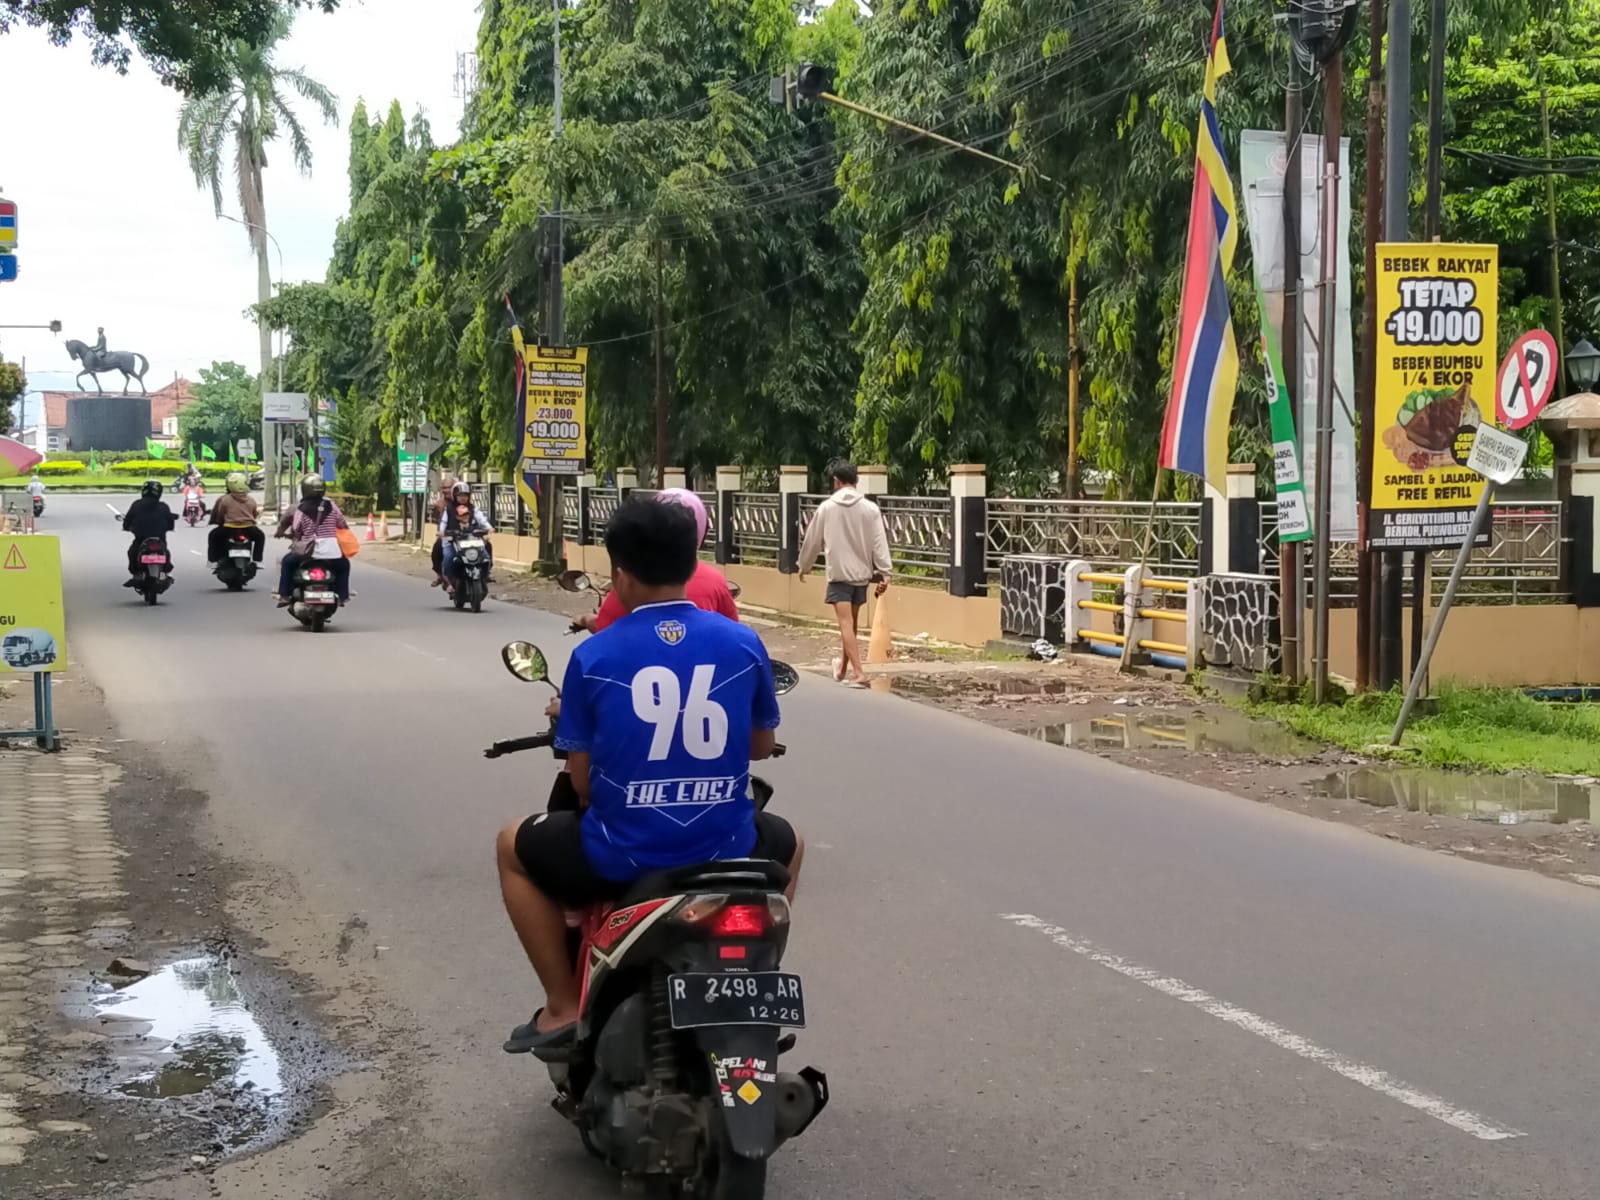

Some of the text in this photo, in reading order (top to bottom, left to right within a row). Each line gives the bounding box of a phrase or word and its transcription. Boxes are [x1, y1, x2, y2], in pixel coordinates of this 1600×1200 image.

[1383, 257, 1491, 274] BEBEK RAKYAT
[1399, 280, 1475, 308] TETAP
[1392, 355, 1483, 370] BEBEK BUMBU
[1433, 370, 1474, 386] EKOR
[553, 397, 577, 406] EKOR
[1384, 473, 1485, 486] SAMBEL & LALAPAN
[1397, 486, 1472, 501] FREE REFILL
[631, 664, 729, 761] 96
[626, 779, 736, 805] THE EAST
[674, 977, 800, 999] R 2498 AR
